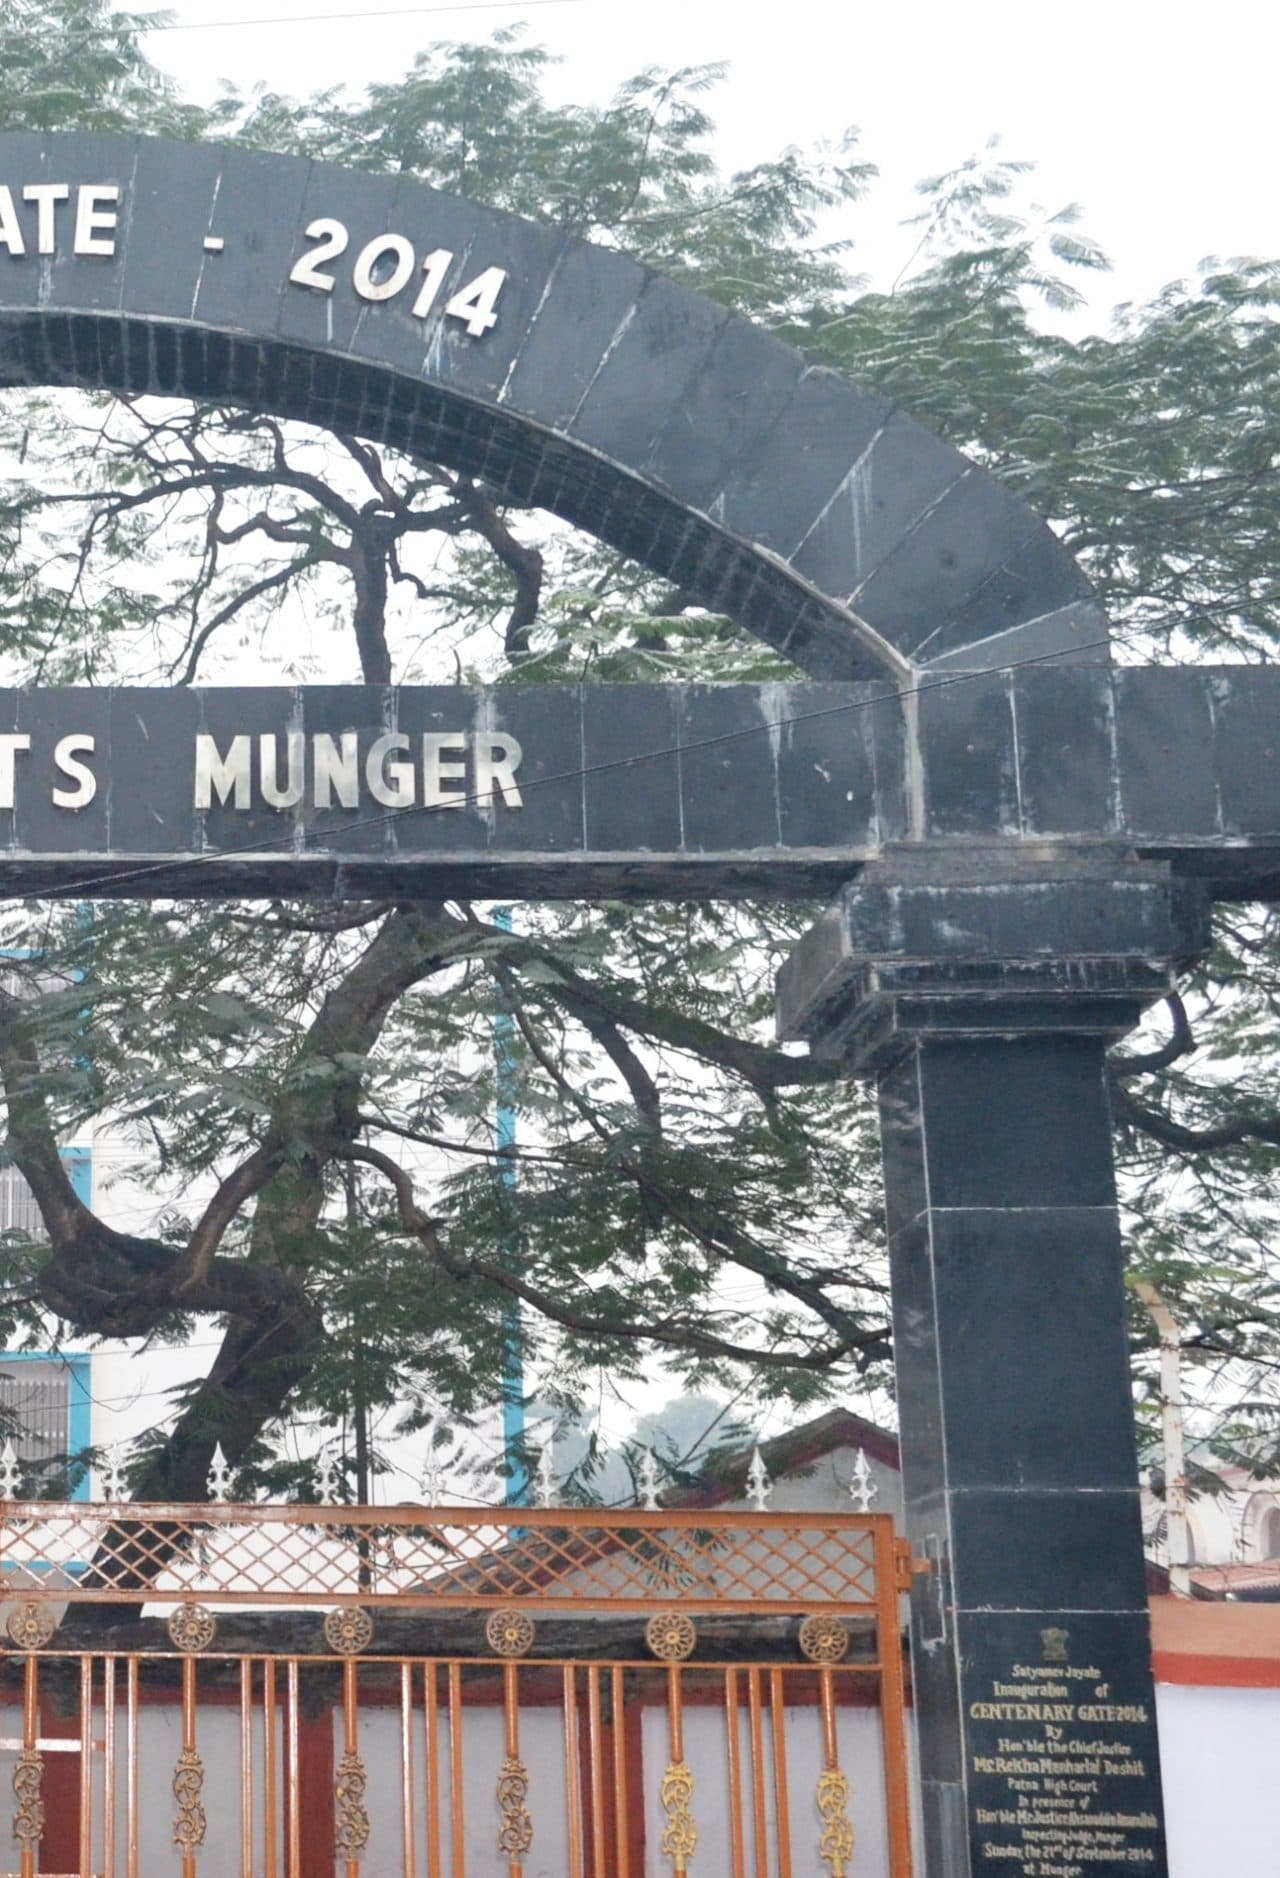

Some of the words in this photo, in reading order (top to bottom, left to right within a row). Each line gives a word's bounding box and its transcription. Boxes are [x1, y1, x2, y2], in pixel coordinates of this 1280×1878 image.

[288, 217, 508, 338] 2014
[194, 731, 524, 810] MUNGER
[1095, 1683, 1109, 1698] of
[970, 1703, 1073, 1720] CENTENARY
[1078, 1704, 1116, 1721] GATE
[1045, 1724, 1063, 1740] By
[1047, 1740, 1067, 1754] the
[1008, 1777, 1038, 1791] Patna
[1069, 1780, 1098, 1793] Court
